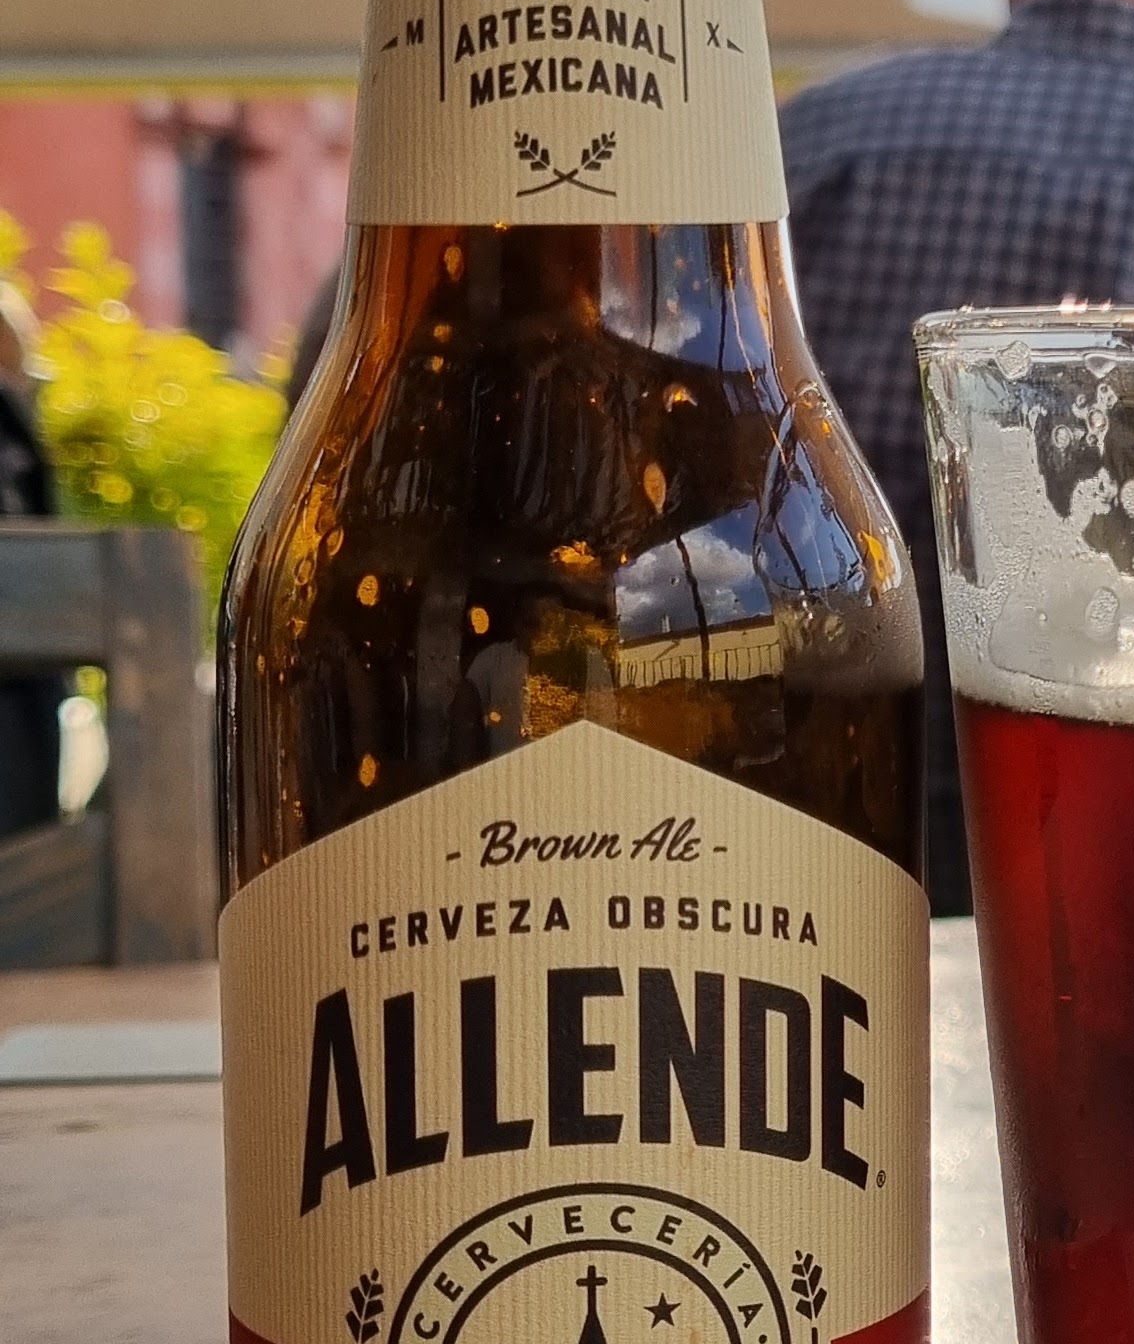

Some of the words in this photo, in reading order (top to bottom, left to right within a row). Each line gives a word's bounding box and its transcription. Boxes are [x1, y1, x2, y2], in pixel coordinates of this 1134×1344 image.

[406, 19, 424, 46] M
[454, 5, 676, 64] ARTESANAL
[470, 58, 664, 110] MEXICANA
[479, 820, 622, 868] Brown
[631, 816, 701, 862] Ale
[351, 897, 570, 958] CERVEZA
[608, 895, 818, 947] OBSCURA
[300, 966, 870, 1218] ALLENDE
[413, 1204, 765, 1341] CERVECERÍA
